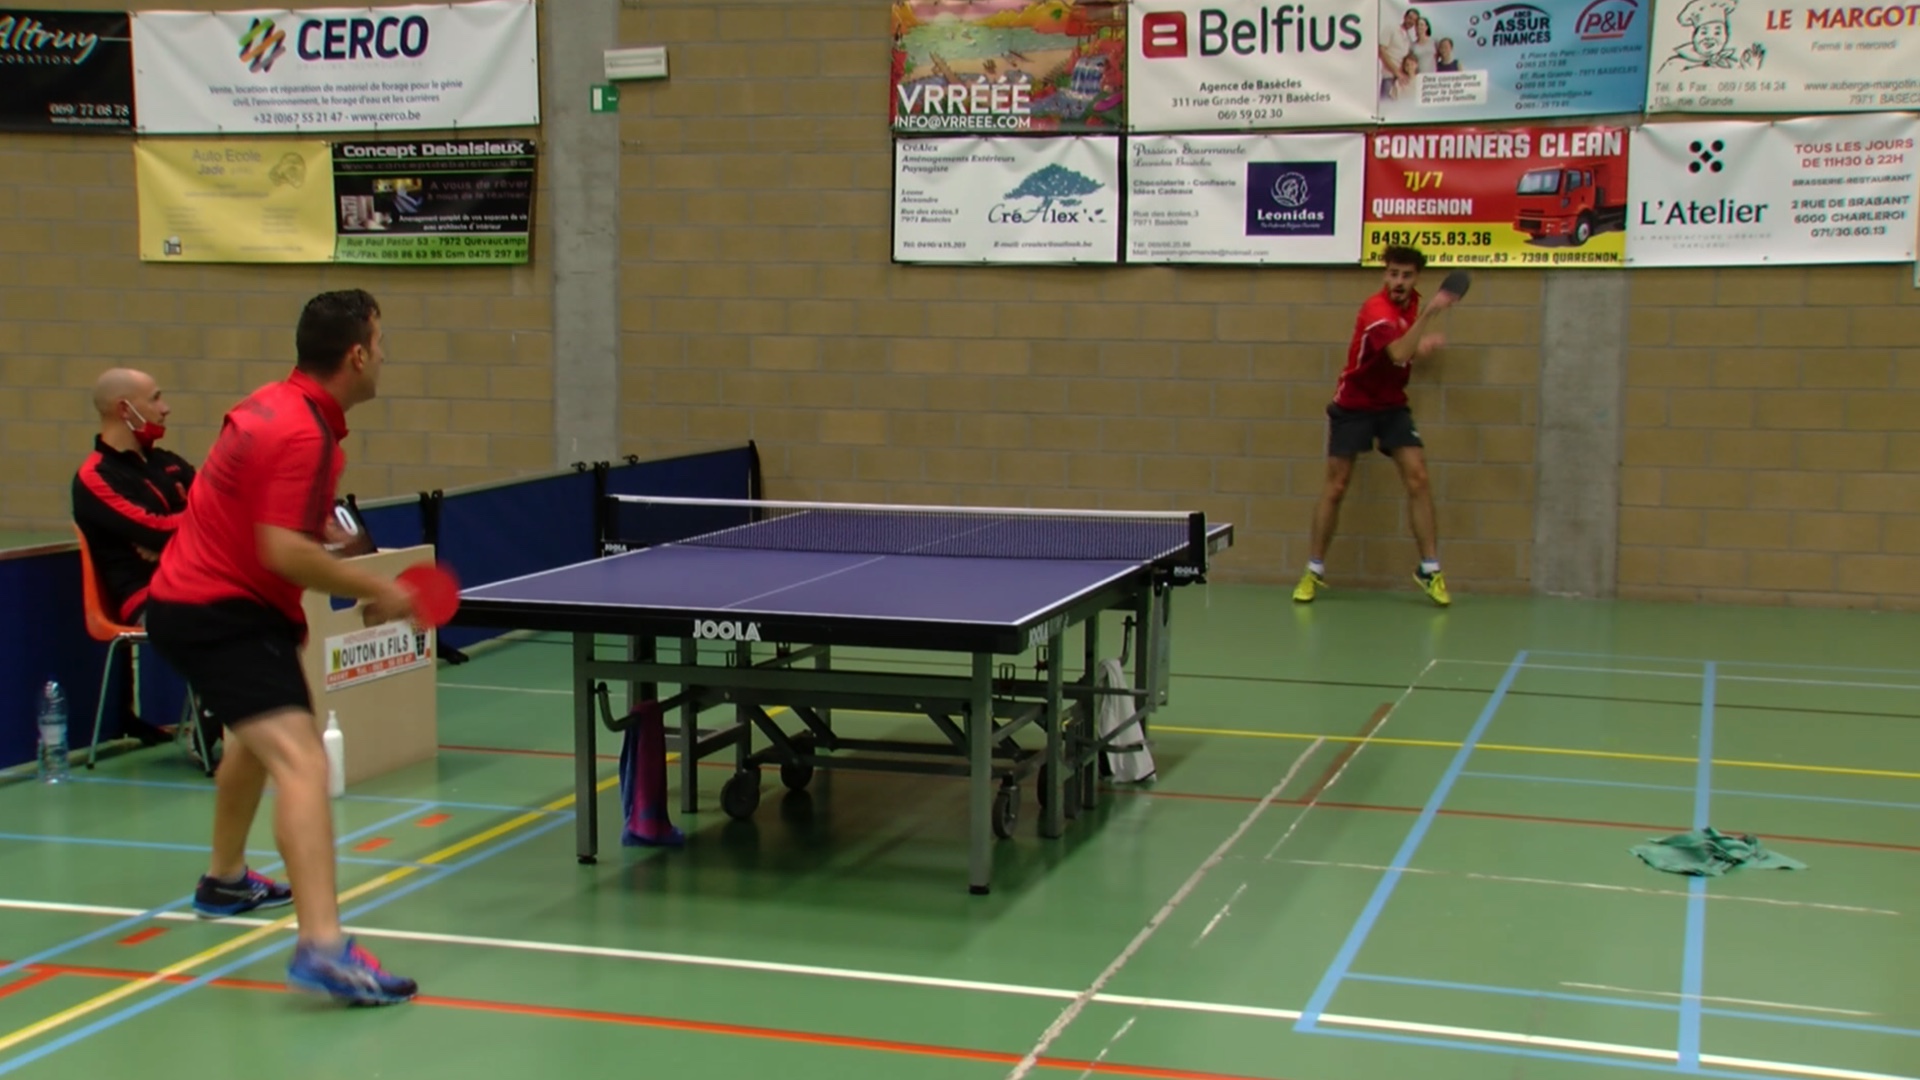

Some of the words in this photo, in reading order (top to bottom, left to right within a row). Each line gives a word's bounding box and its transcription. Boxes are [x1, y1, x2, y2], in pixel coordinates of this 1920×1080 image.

[1494, 16, 1550, 32] ASSUR
[1584, 10, 1635, 33] P&V
[1766, 9, 1792, 31] LE
[1806, 4, 1920, 29] MARGOT
[1200, 5, 1362, 56] Belfius
[297, 15, 428, 61] CERCO
[1492, 30, 1551, 46] FINANCES
[1811, 40, 1841, 52] Fermé
[1844, 41, 1852, 50] le
[1858, 40, 1896, 50] mercredi
[1598, 66, 1638, 75] BASECLES
[209, 85, 232, 95] Vente,
[235, 84, 269, 94] location
[271, 84, 278, 93] et
[280, 82, 321, 96] réparation
[323, 82, 334, 93] de
[337, 82, 368, 92] matériel
[370, 82, 380, 92] de
[382, 80, 408, 93] forage
[410, 82, 429, 93] pour
[432, 80, 440, 90] le
[440, 80, 462, 91] génie
[1200, 81, 1238, 92] Agence
[1242, 80, 1254, 90] de
[1256, 79, 1301, 90] Basècles
[1676, 82, 1683, 92] &
[1718, 82, 1736, 92] 069
[1760, 82, 1771, 92] 14
[1773, 82, 1786, 91] 24
[233, 97, 250, 107] civil,
[322, 96, 328, 106] le
[331, 95, 356, 107] forage
[359, 95, 380, 106] d'eau
[382, 95, 390, 104] et
[393, 94, 404, 104] les
[406, 94, 440, 104] carrières
[897, 76, 1031, 114] VRRÉÉÉ
[1172, 98, 1190, 108] 311
[1193, 99, 1208, 107] rue
[1212, 96, 1249, 106] Grande
[1258, 95, 1283, 104] 7971
[1286, 92, 1330, 102] Basècles
[1699, 96, 1734, 106] Grande
[1850, 94, 1874, 105] 7971
[79, 103, 94, 116] 77
[1218, 110, 1237, 120] 069
[1240, 110, 1252, 120] 59
[1255, 110, 1266, 119] 02
[1270, 109, 1282, 118] 30
[253, 113, 272, 124] +32
[274, 112, 299, 125] (0)67
[302, 113, 314, 123] 55
[316, 112, 327, 122] 21
[330, 112, 342, 122] 47
[351, 110, 420, 122] www.cerco.be
[895, 116, 1030, 128] INFO@VRREEE.COM
[344, 144, 416, 158] Concept
[902, 144, 938, 152] CréAlex
[1133, 144, 1177, 156] Passion
[1182, 143, 1246, 156] Gourmande
[1374, 134, 1530, 159] CONTAINERS
[1540, 132, 1621, 156] CLEAN
[1795, 143, 1832, 154] TOUS
[1836, 142, 1861, 153] LES
[1866, 138, 1914, 152] JOURS
[192, 150, 222, 162] Auto
[226, 149, 260, 162] Ecole
[902, 155, 968, 165] Aménagements
[970, 154, 1015, 163] Extérieurs
[1802, 158, 1820, 168] DE
[1824, 156, 1862, 168] 11H30
[1865, 155, 1874, 166] à
[1878, 154, 1904, 165] 22H
[198, 164, 225, 176] Jade
[902, 164, 948, 174] Paysagiste
[444, 182, 471, 190] vous
[476, 180, 490, 190] de
[494, 179, 528, 189] rêver
[1133, 178, 1184, 188] Chocolaterie
[1193, 178, 1236, 187] Confiserie
[1792, 174, 1911, 187] BRASSERIE-RESTAURANT
[1133, 187, 1156, 195] Idées
[1158, 187, 1193, 196] Cadeaux
[1372, 198, 1473, 219] QUAREGNON
[1792, 200, 1798, 210] 2
[1801, 200, 1826, 209] RUE
[1828, 199, 1844, 208] DE
[1848, 196, 1910, 208] BRABANT
[484, 214, 508, 222] espaces
[1257, 208, 1324, 221] Leonidas
[1640, 199, 1768, 226] L'Atelier
[1794, 214, 1826, 224] 6000
[1832, 211, 1905, 222] CHARLEROI
[1811, 227, 1886, 238] 071/30.60.13
[347, 238, 363, 246] Rue
[366, 237, 384, 246] Paul
[417, 237, 428, 246] 53
[440, 237, 460, 246] 7972
[465, 236, 526, 248] Quevaucamps
[446, 250, 466, 258] Gsm
[468, 250, 491, 258] 0475
[495, 250, 511, 258] 297
[1440, 252, 1453, 262] du
[1552, 252, 1618, 263] QUAREGNON
[334, 506, 358, 536] 0
[693, 620, 760, 641] JOOLA
[332, 642, 376, 671] MOUTON
[388, 634, 408, 656] FILS
